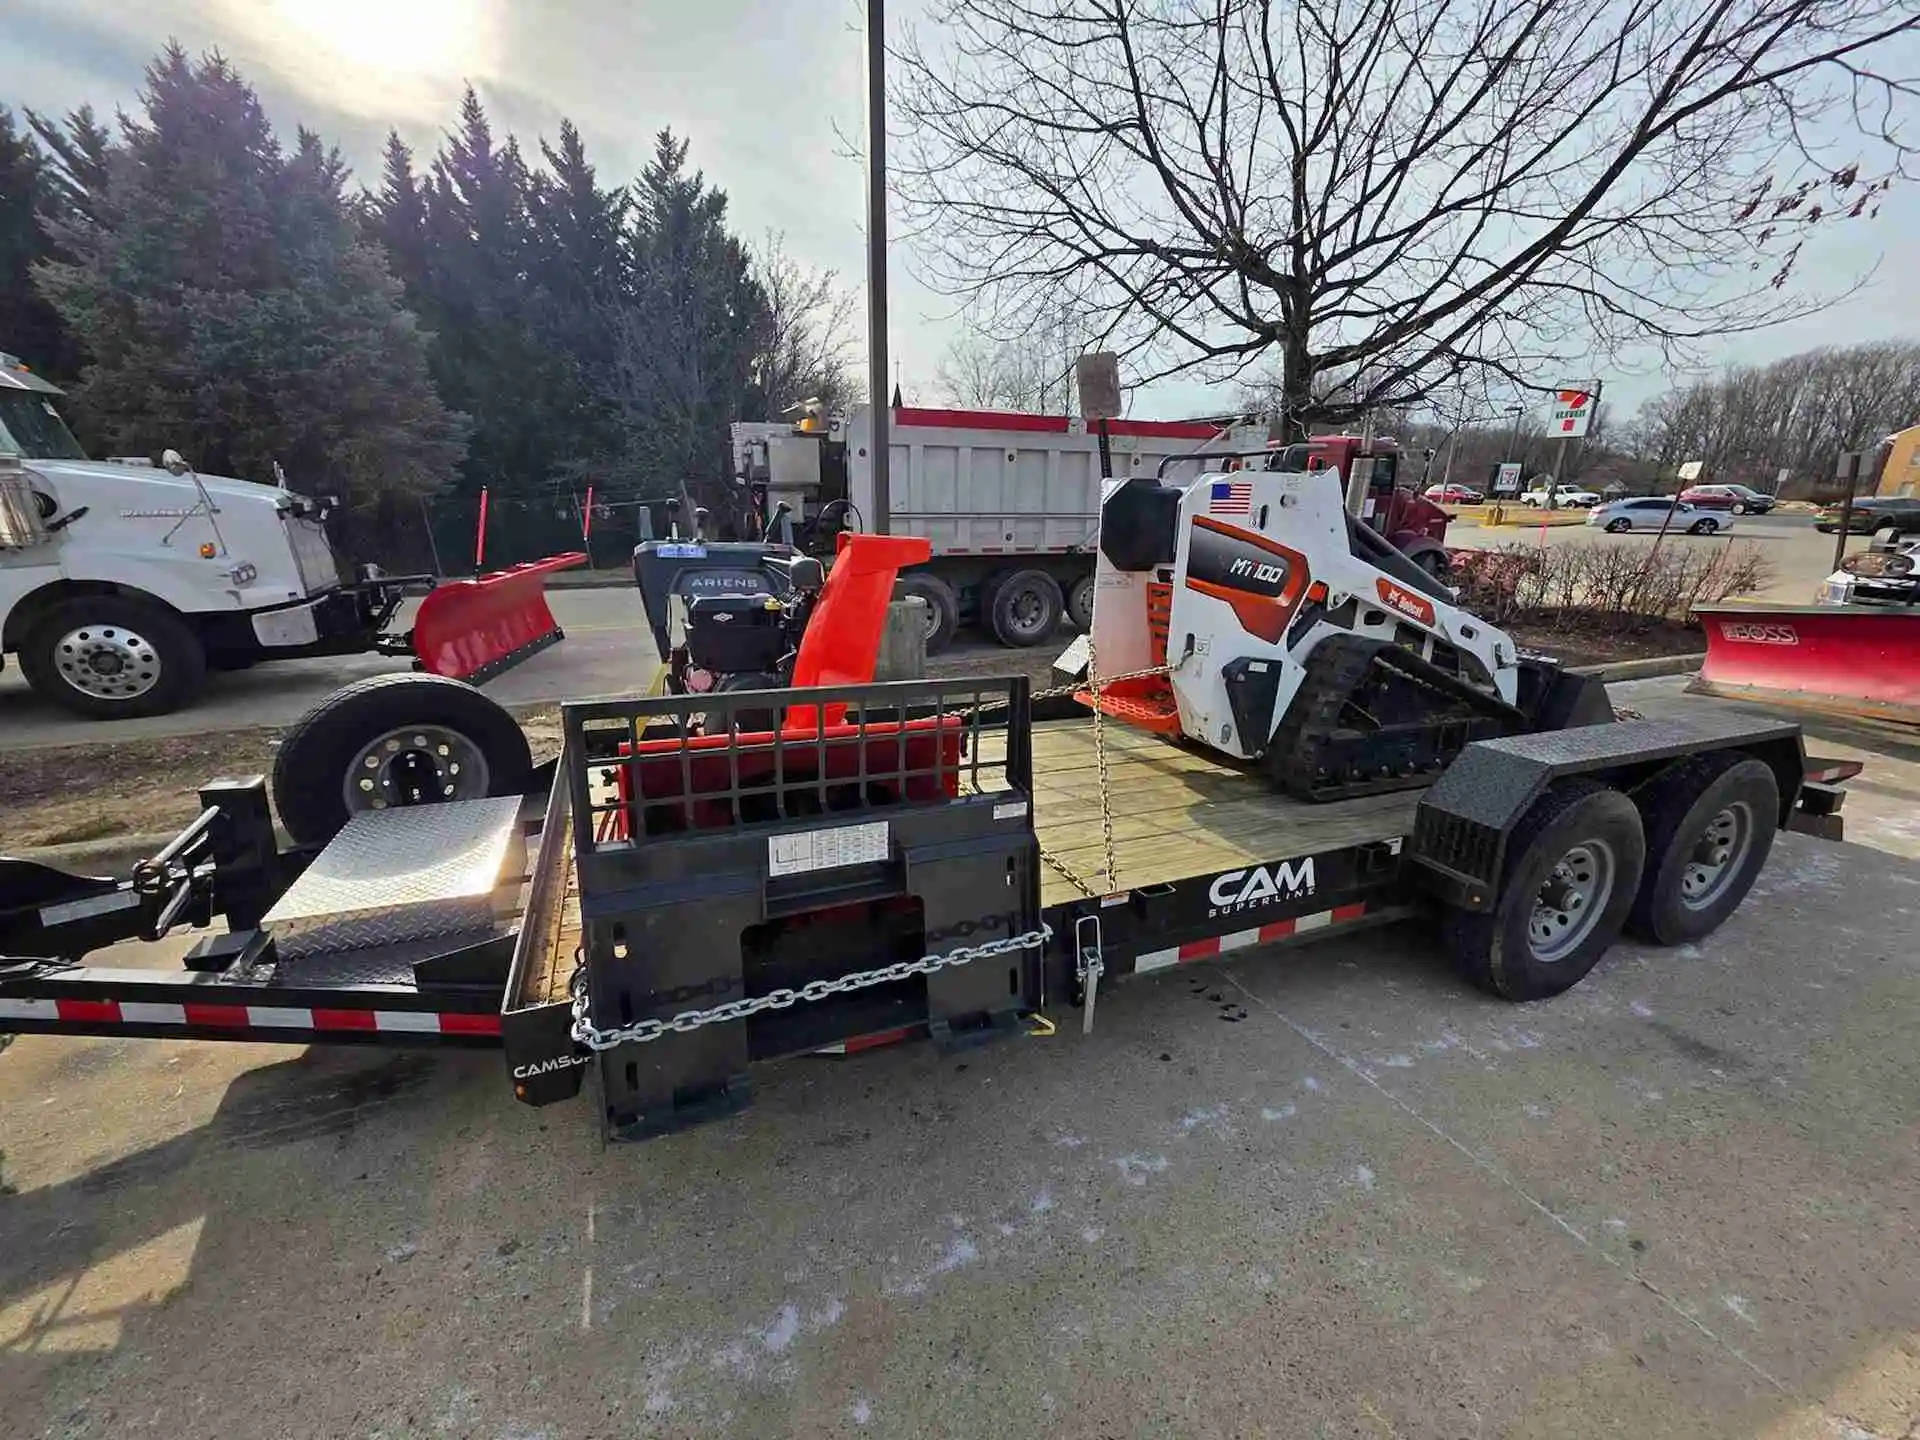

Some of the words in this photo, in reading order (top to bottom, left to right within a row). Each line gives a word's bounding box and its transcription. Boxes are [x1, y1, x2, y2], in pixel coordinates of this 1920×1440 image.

[691, 578, 758, 588] ARIENS
[1734, 622, 1794, 641] BOSS
[1208, 857, 1316, 906] CAM
[1208, 887, 1316, 918] SUPERLINE
